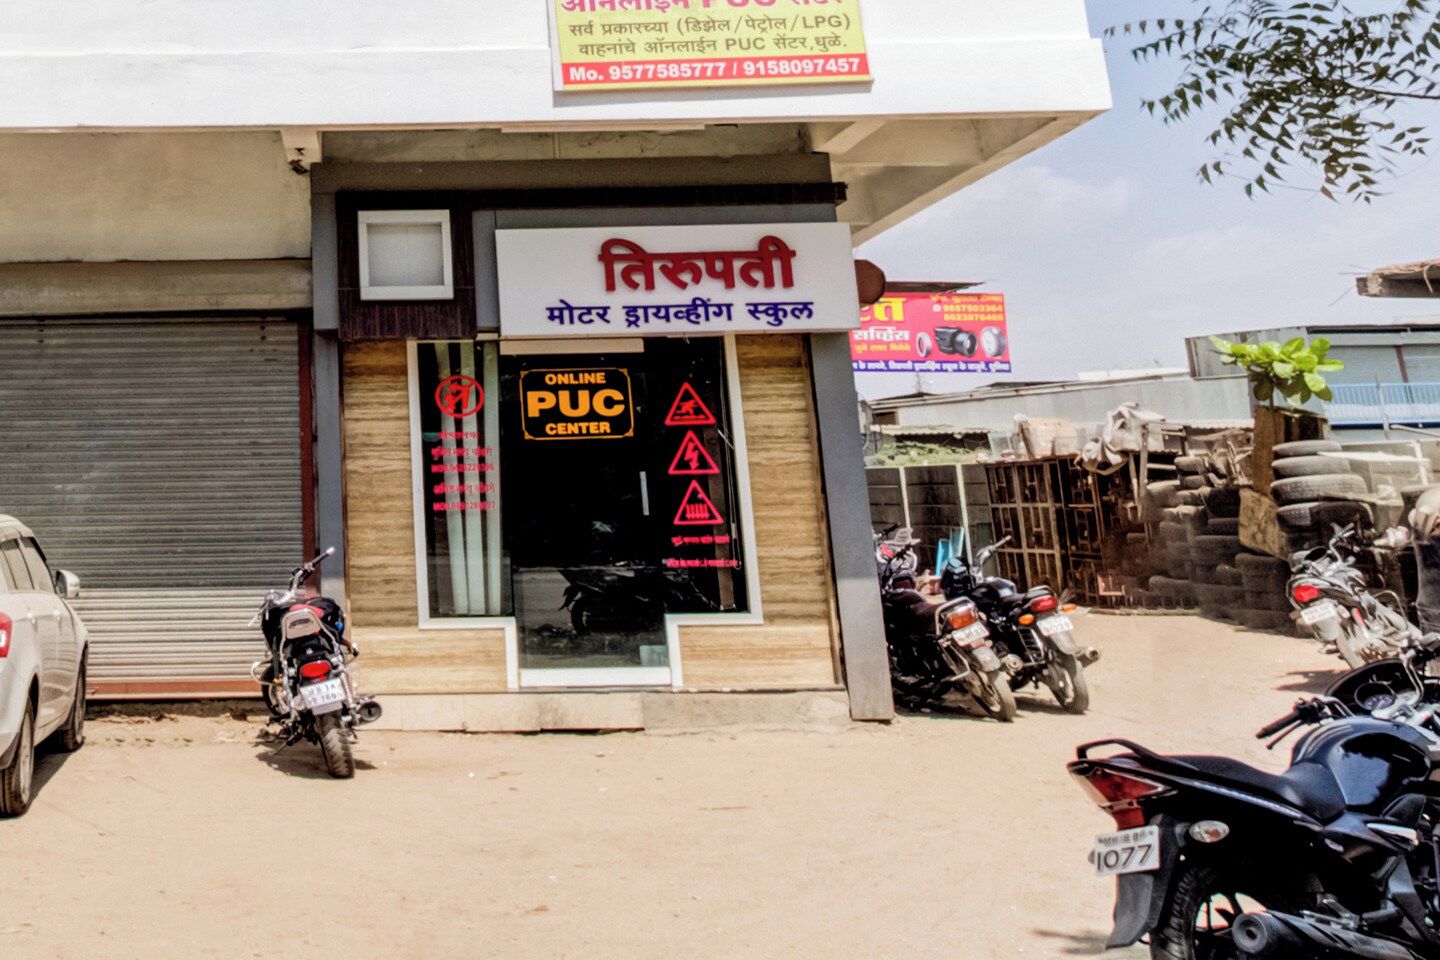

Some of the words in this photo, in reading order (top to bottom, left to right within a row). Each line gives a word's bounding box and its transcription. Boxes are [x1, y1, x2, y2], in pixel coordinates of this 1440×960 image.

[568, 19, 593, 36] सर्व
[601, 20, 668, 35] प्रकारच्या
[578, 39, 636, 57] वाहनांचे
[644, 37, 717, 57] ऑनलाईन
[725, 37, 766, 51] PUC
[569, 66, 604, 82] Mo.
[609, 61, 727, 80] 9577585777
[743, 57, 860, 75] 9158097457
[546, 299, 611, 325] मोटर
[745, 301, 814, 326] स्कुल
[544, 372, 607, 386] ONLINE
[526, 388, 625, 418] PUC
[545, 421, 611, 435] CENTER
[1097, 843, 1152, 871] 1077
